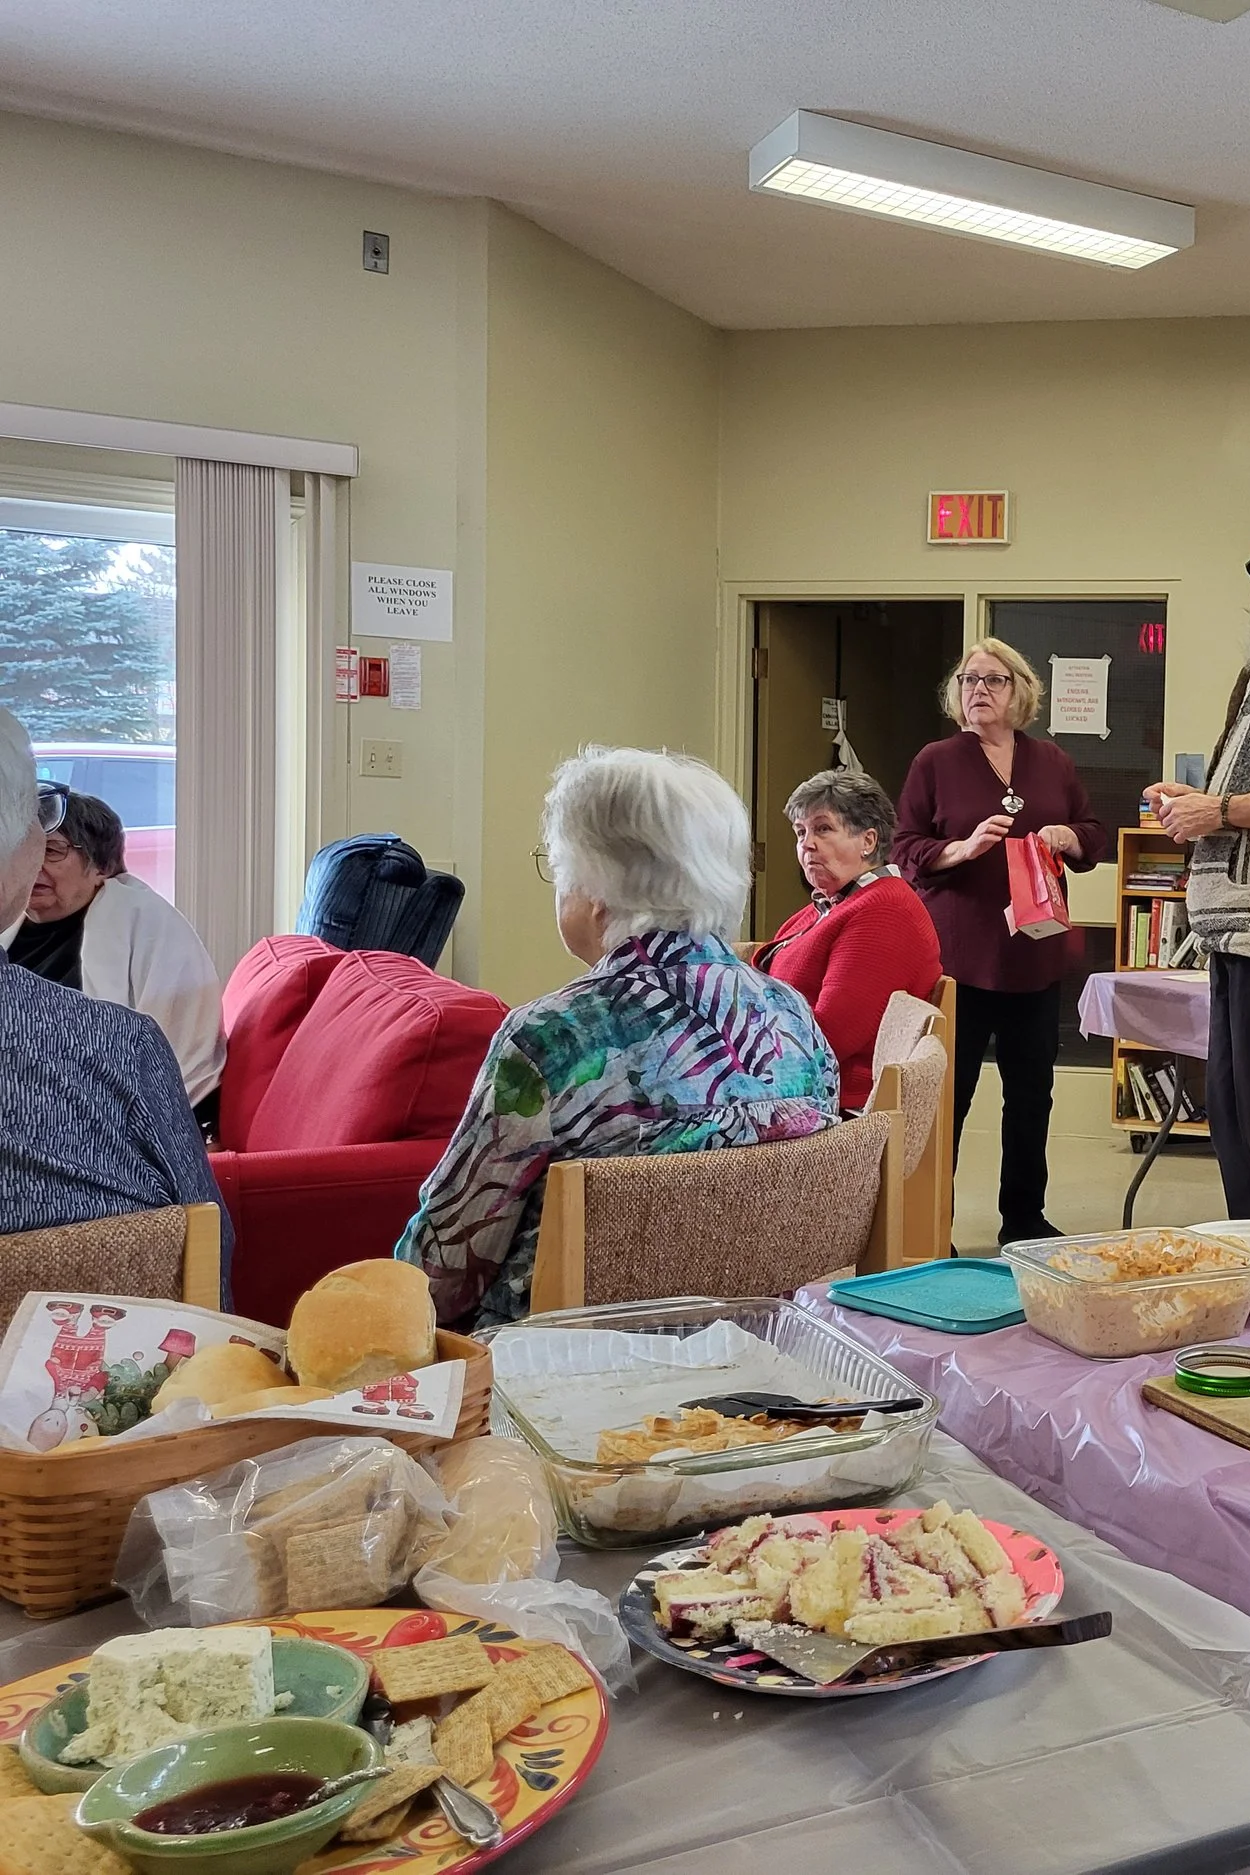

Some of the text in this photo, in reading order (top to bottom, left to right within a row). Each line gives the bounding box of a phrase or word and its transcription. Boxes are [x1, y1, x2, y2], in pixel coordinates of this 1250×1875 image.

[938, 495, 1003, 538] EXIT
[368, 576, 437, 589] PLEASE CLOSE
[368, 586, 436, 598] ALL WINDOWS
[377, 596, 429, 608] WHEN YOU
[387, 606, 419, 616] LEAVE
